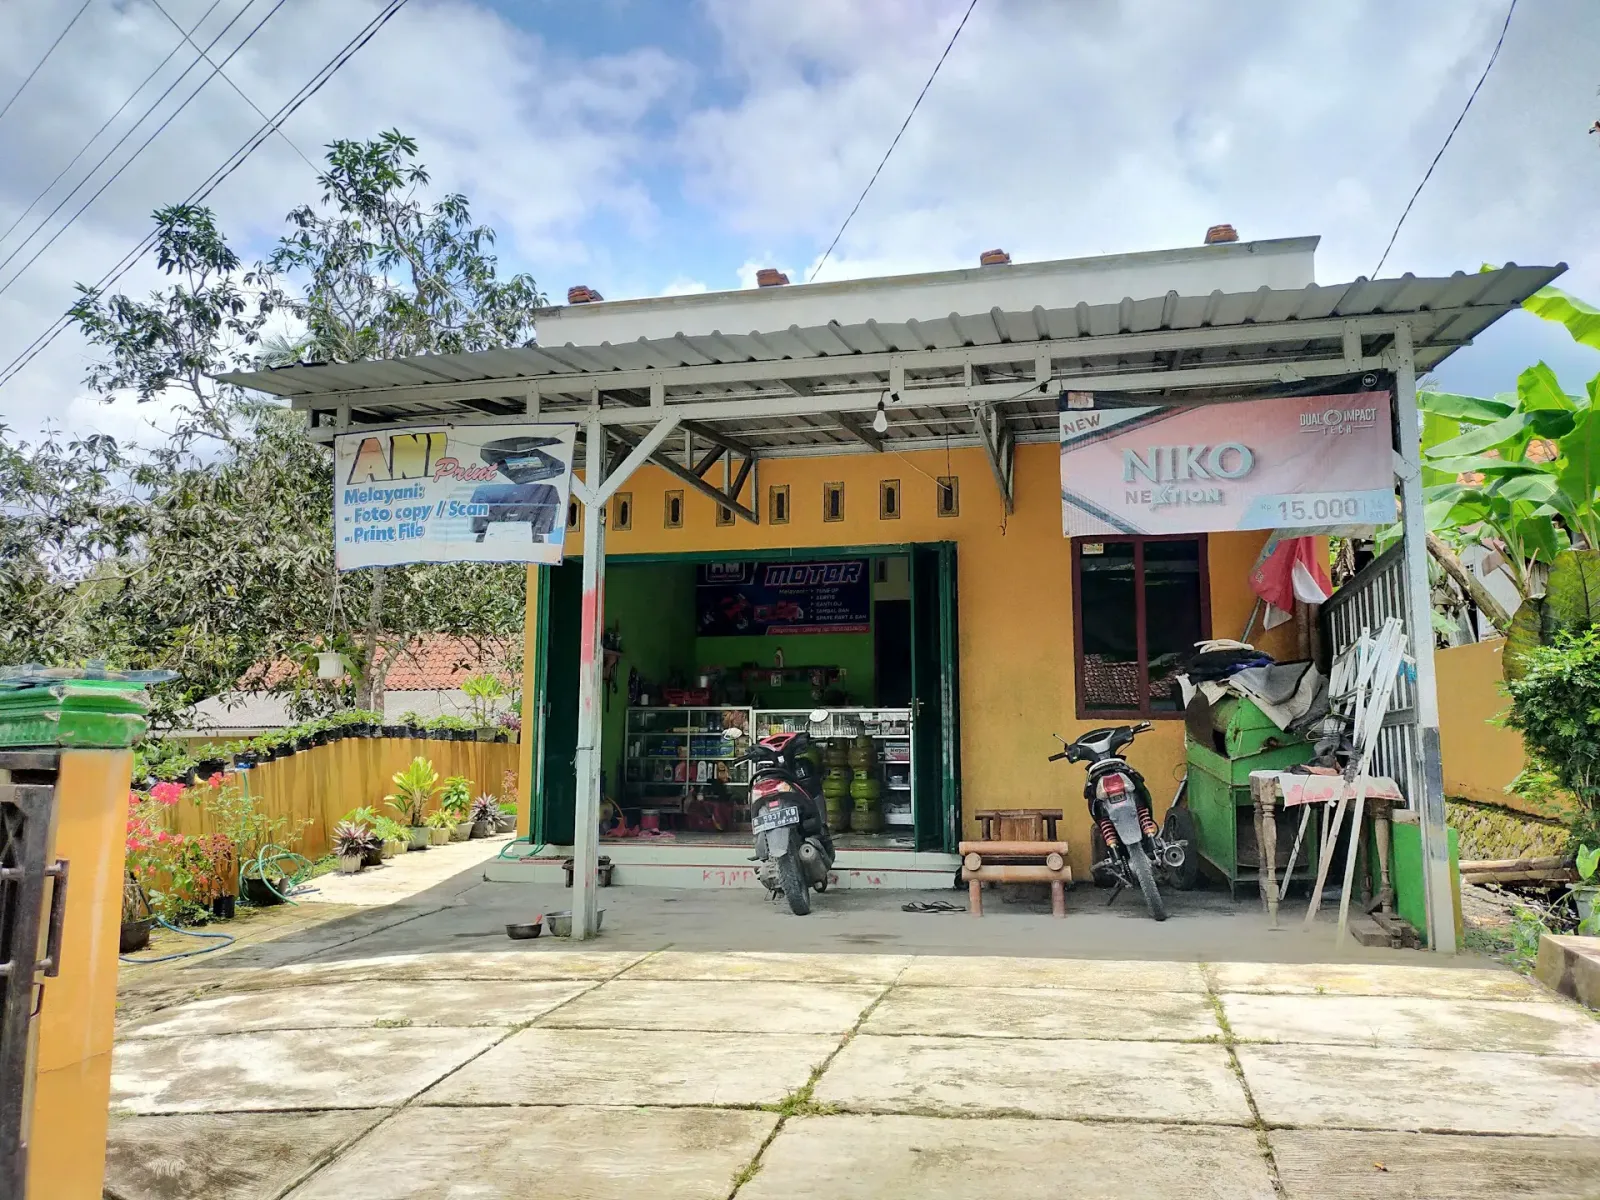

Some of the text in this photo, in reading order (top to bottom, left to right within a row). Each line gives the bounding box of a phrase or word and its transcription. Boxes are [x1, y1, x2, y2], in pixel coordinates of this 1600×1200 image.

[1062, 414, 1101, 435] NEW
[1299, 408, 1377, 426] DUAL IMPACT
[1322, 425, 1353, 435] TECH
[346, 432, 448, 485] ANI
[432, 457, 500, 483] Print
[1120, 442, 1255, 483] NIKO
[344, 484, 425, 505] Melayani:
[1124, 485, 1223, 509] NEXTION
[354, 506, 392, 523] Foto
[395, 504, 434, 521] copy
[448, 500, 489, 517] Scan
[1277, 497, 1358, 520] 15.000
[354, 525, 396, 544] Print
[398, 522, 426, 539] File
[764, 562, 863, 586] MOTOR
